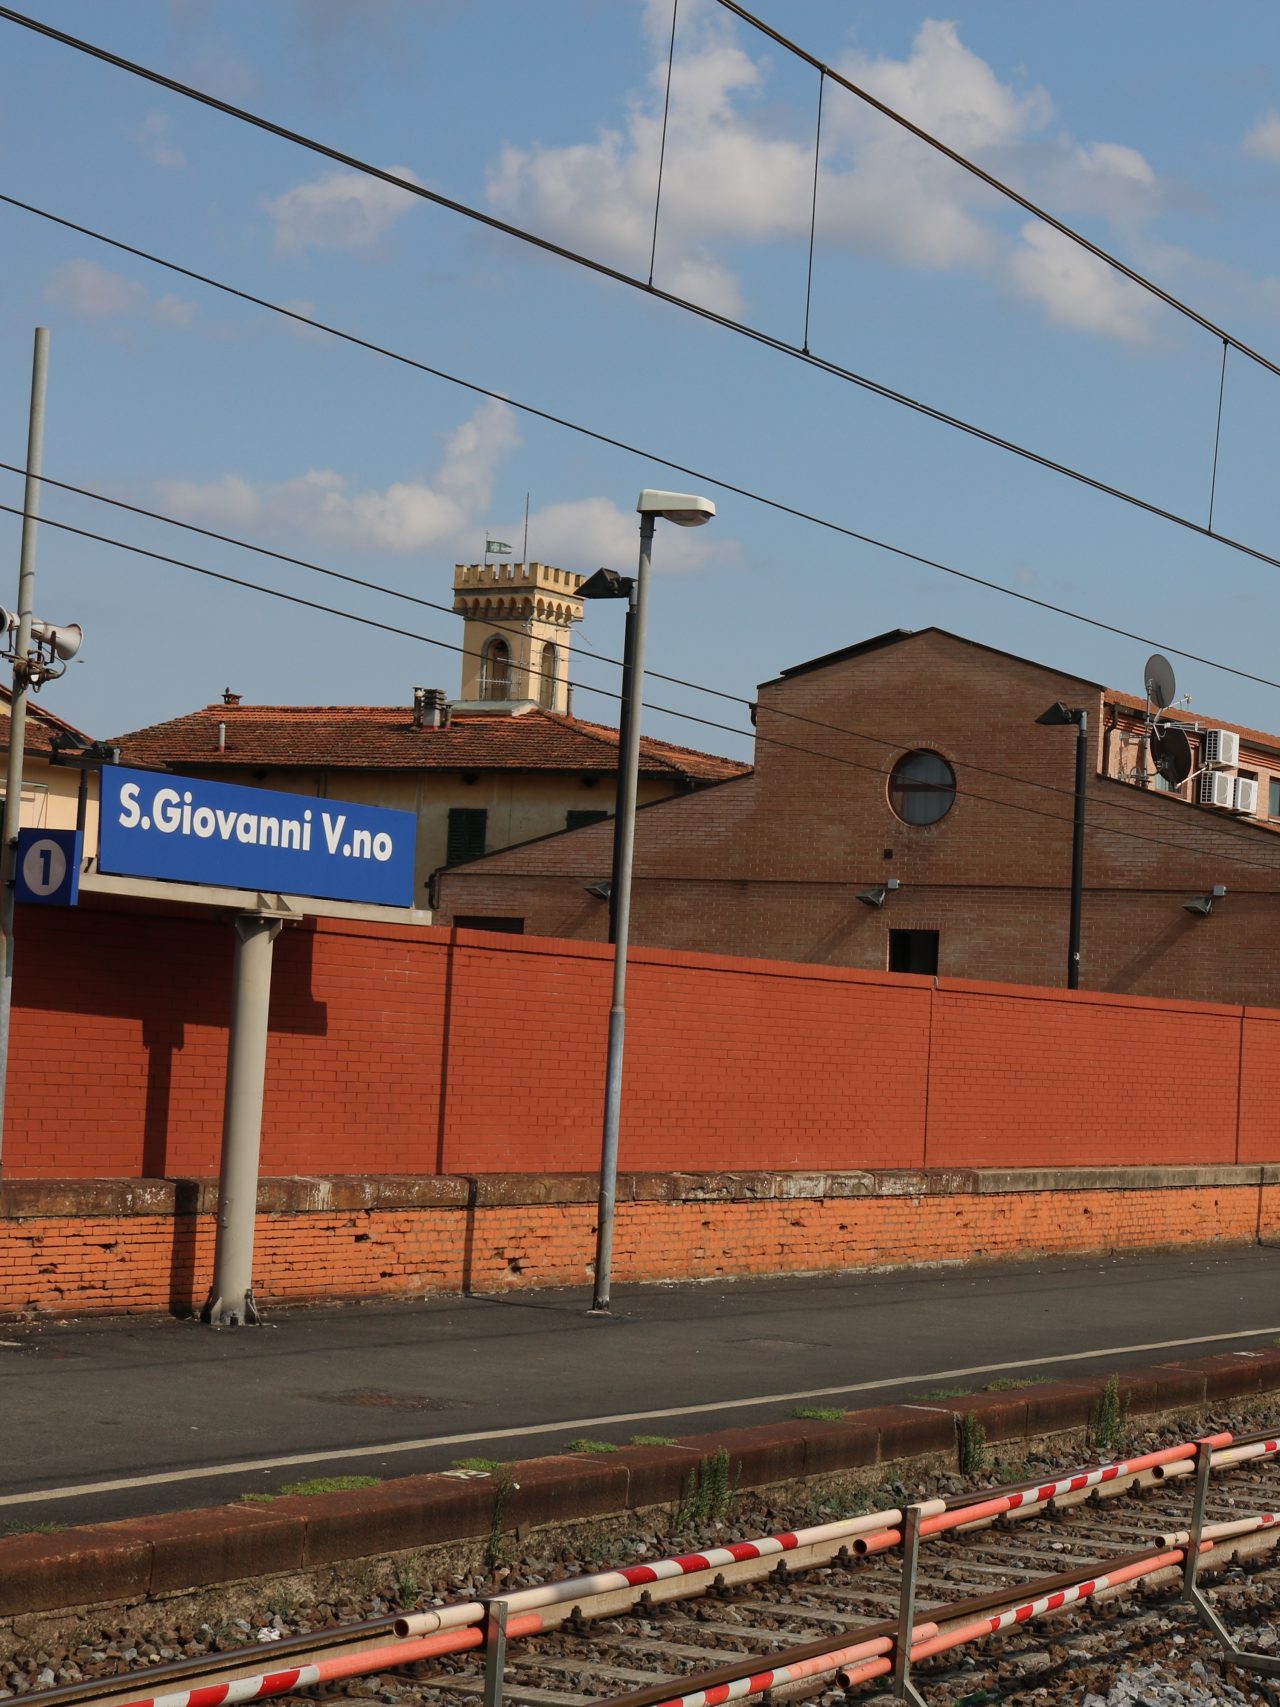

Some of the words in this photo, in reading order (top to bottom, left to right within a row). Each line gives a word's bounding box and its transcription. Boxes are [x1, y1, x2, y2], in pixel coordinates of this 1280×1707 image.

[119, 782, 312, 851] S.Giovanni
[321, 812, 393, 862] V.no
[39, 849, 53, 886] 1
